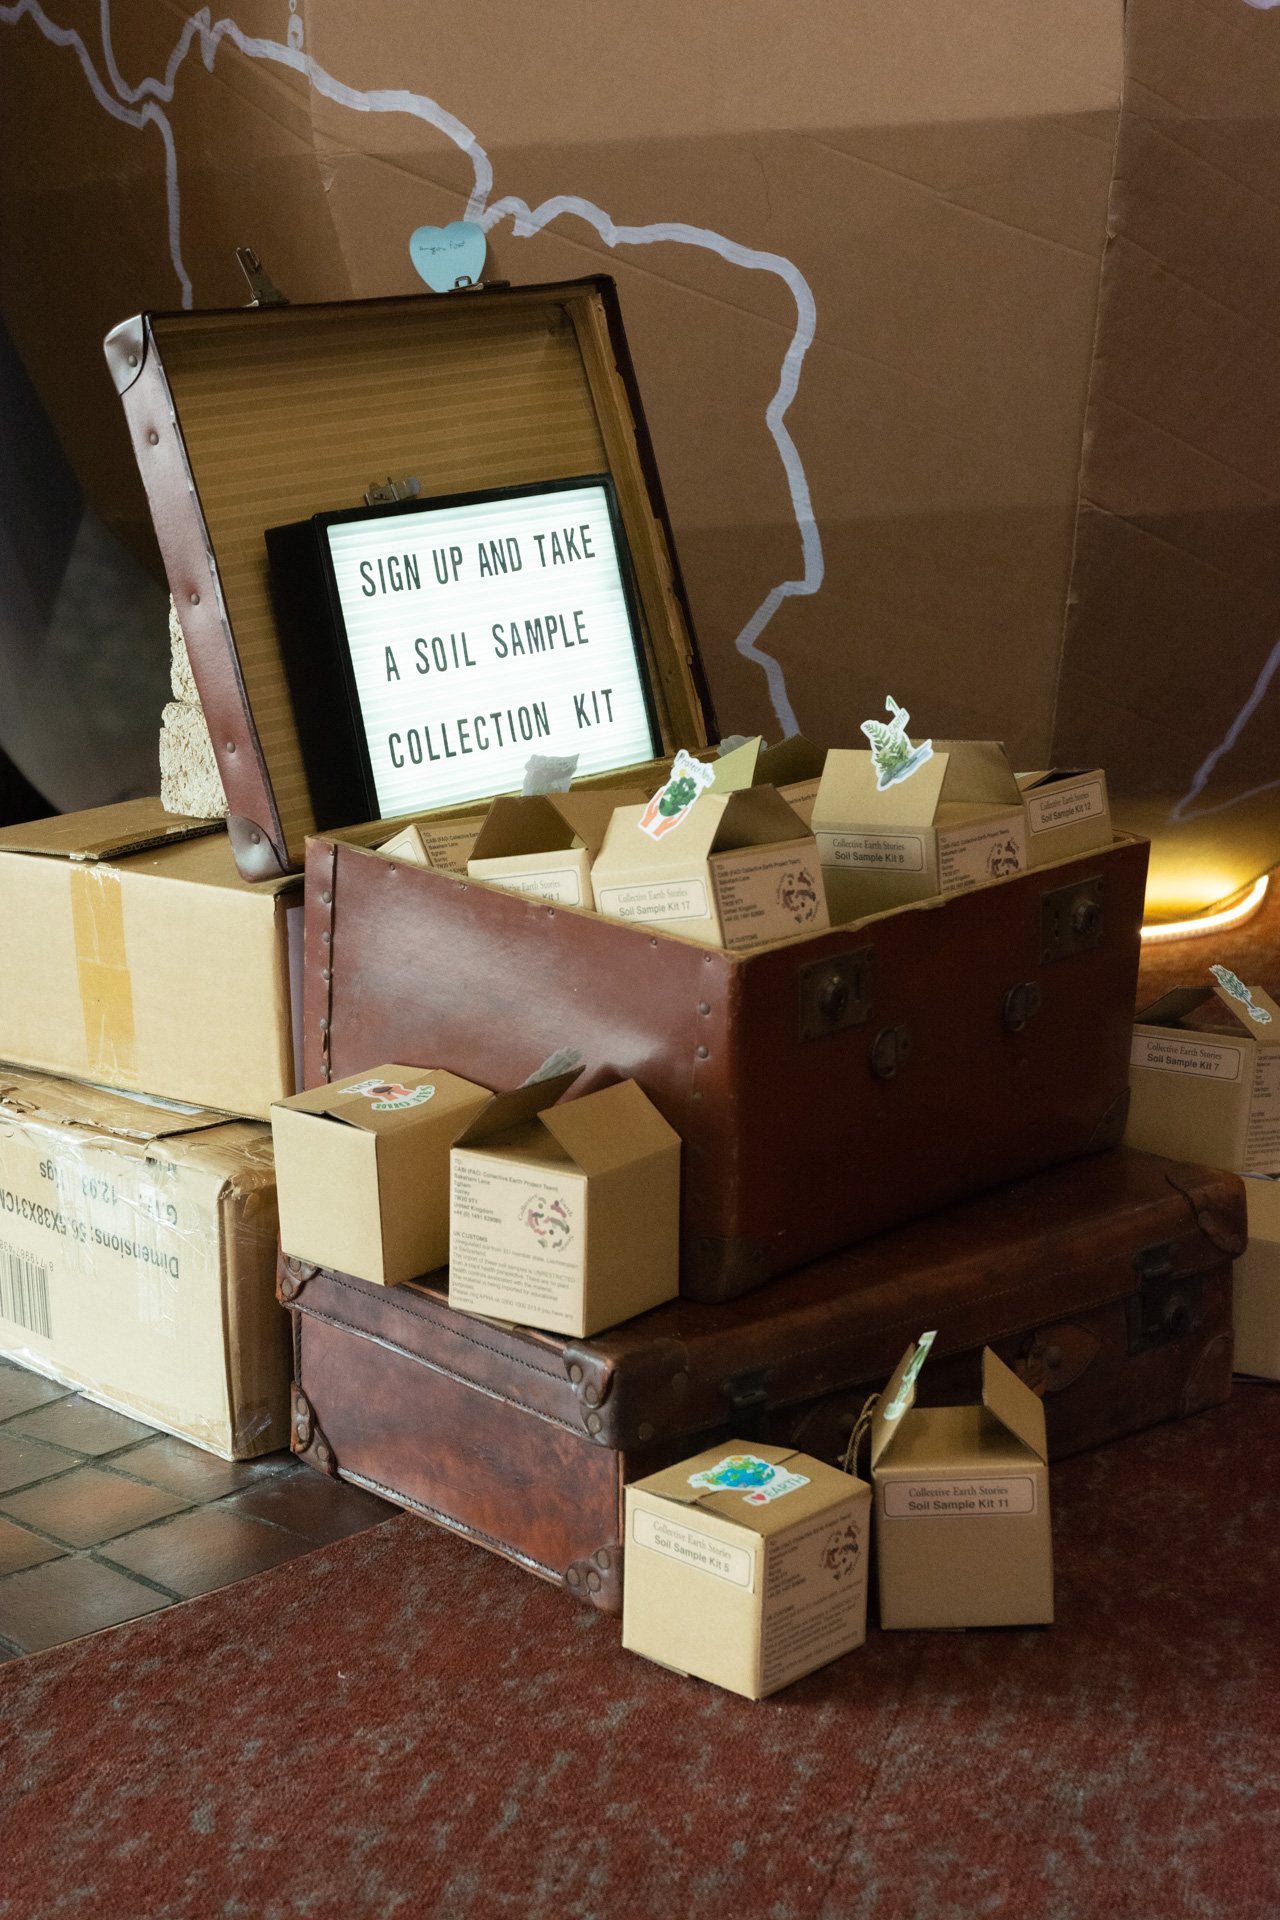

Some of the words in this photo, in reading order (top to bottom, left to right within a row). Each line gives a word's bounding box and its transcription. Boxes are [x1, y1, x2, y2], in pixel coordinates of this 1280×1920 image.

[359, 553, 421, 597] SIGN
[432, 546, 463, 585] UP
[478, 537, 523, 578] AND
[533, 524, 596, 568] TAKE
[384, 646, 401, 682] A
[414, 631, 476, 675] SOIL
[492, 610, 589, 659] SAMPLE
[388, 701, 551, 769] COLLECTION
[573, 688, 613, 729] KIT
[1040, 813, 1053, 824] Soil
[1053, 807, 1075, 820] Sample
[1075, 803, 1084, 813] Kit
[1084, 801, 1092, 811] 12
[832, 838, 863, 849] Collective
[864, 840, 882, 850] Earth
[883, 840, 905, 851] Stories
[834, 850, 851, 860] Soil
[852, 851, 884, 863] Sample
[885, 853, 897, 863] Kit
[898, 854, 905, 864] 8
[619, 907, 635, 917] Soil
[636, 903, 666, 915] Sample
[668, 901, 680, 911] Kit
[681, 901, 690, 910] 17
[1147, 1042, 1178, 1055] Collective
[1180, 1046, 1198, 1057] Earth
[1199, 1049, 1222, 1060] Stories
[1147, 1053, 1164, 1063] Soil
[1165, 1056, 1198, 1068] Sample
[1199, 1060, 1212, 1070] Kit
[1213, 1063, 1220, 1071] 7
[91, 1226, 180, 1279] Dimensions:
[763, 1475, 807, 1497] EARTH
[908, 1486, 951, 1498] Collective
[953, 1486, 977, 1497] Earth
[979, 1485, 1009, 1496] Stories
[908, 1500, 930, 1511] Soil
[933, 1499, 975, 1512] Sample
[978, 1499, 994, 1509] Kit
[997, 1498, 1009, 1508] 11
[653, 1520, 685, 1541] Collective
[687, 1534, 707, 1549] Earth
[708, 1542, 732, 1559] Stories
[654, 1535, 671, 1549] Soil
[673, 1542, 707, 1564] Sample
[709, 1556, 722, 1570] Kit
[724, 1562, 730, 1573] 5
